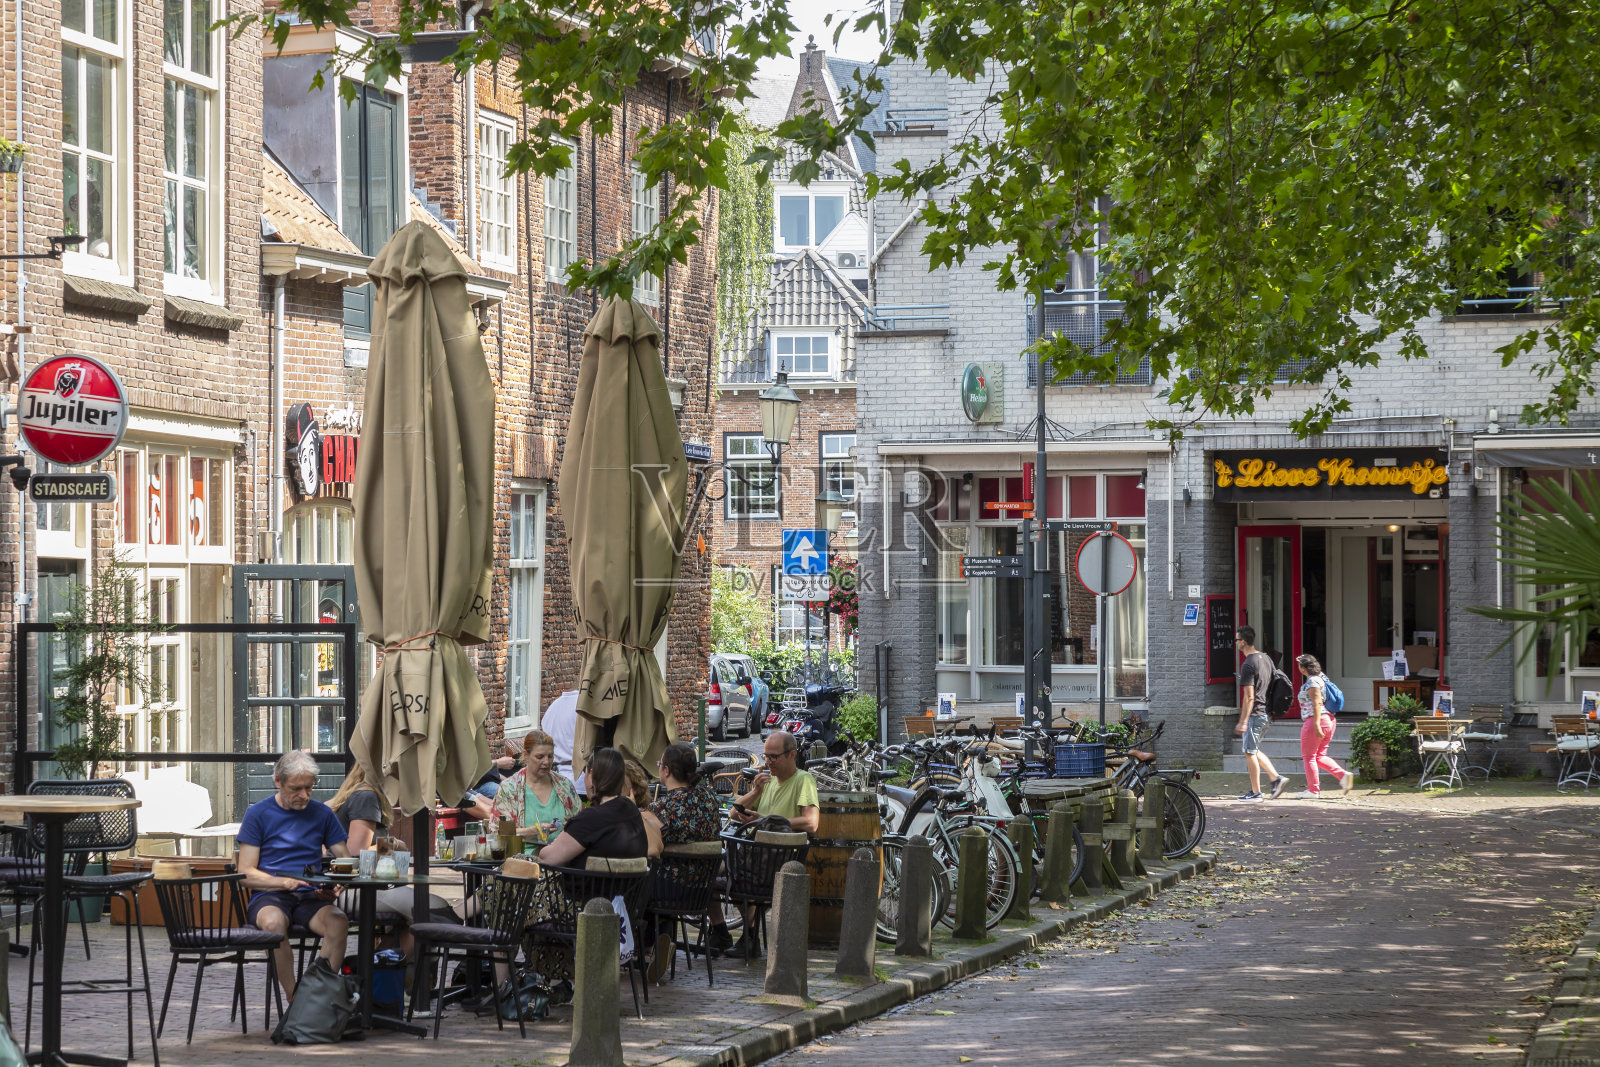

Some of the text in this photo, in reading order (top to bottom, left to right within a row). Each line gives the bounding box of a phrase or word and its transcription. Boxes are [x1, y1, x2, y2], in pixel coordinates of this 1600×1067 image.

[23, 395, 118, 426] Jupiler
[34, 479, 107, 496] STADSCAFÉ
[1234, 458, 1322, 487] Lieve
[1317, 457, 1449, 494] Vrouwtje
